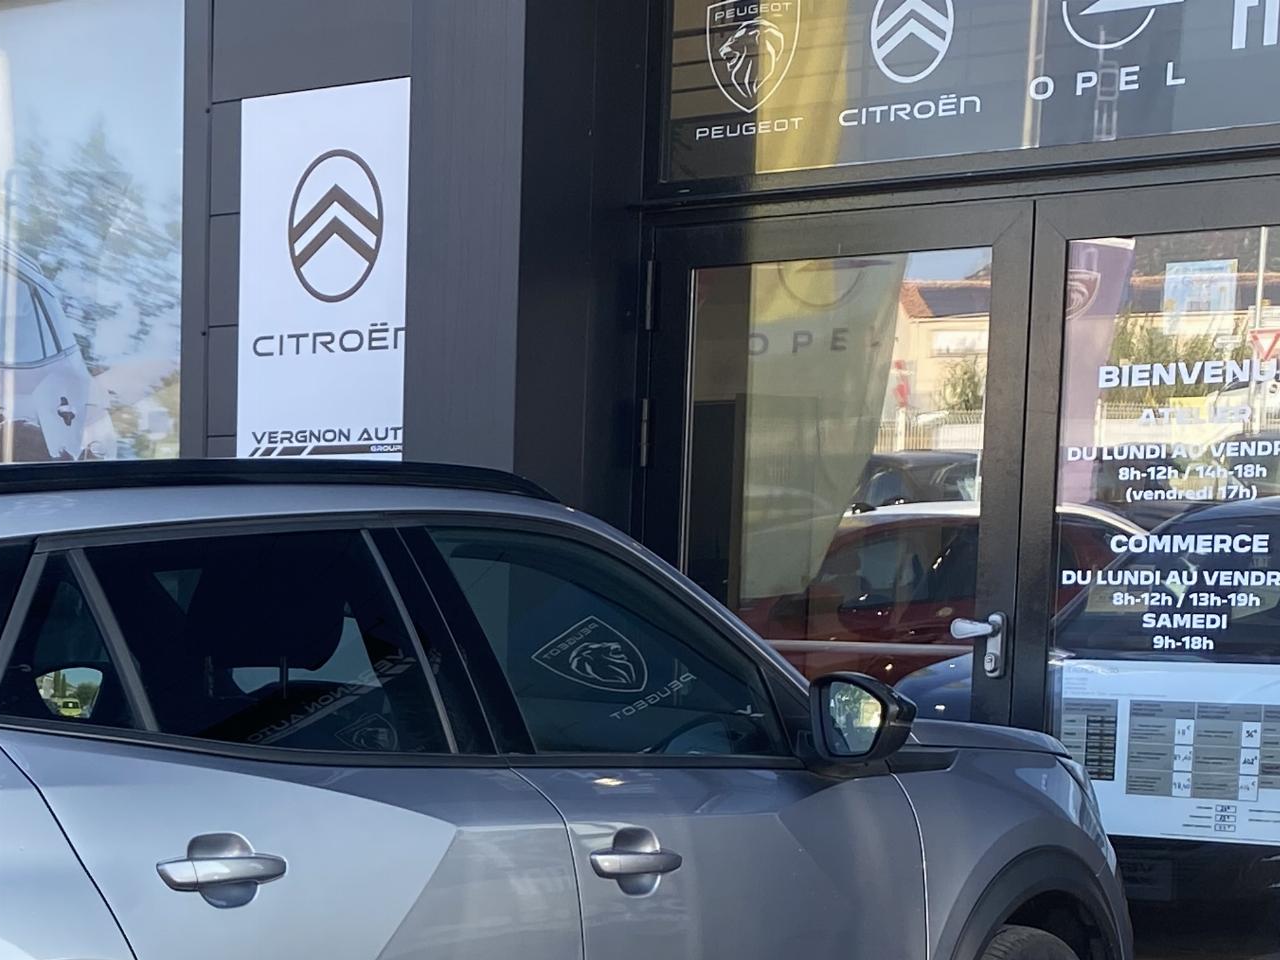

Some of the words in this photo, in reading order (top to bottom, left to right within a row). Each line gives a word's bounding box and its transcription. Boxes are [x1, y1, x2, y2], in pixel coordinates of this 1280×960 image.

[714, 2, 792, 21] PEUGEOT
[1029, 61, 1186, 100] OPEL
[695, 117, 804, 140] PEUGEOT
[1137, 405, 1252, 426] ATELIER
[251, 428, 351, 445] VERGNON
[1067, 446, 1097, 461] DU
[1102, 444, 1167, 461] LUNDI
[1172, 443, 1205, 459] AU
[1118, 465, 1179, 481] 8h-12h
[1195, 463, 1267, 479] 14h-18h
[1125, 486, 1212, 502] (vendredi
[1218, 484, 1258, 501] 17h)
[1110, 533, 1270, 553] COMMERCE
[1061, 570, 1092, 585] DU
[1096, 570, 1161, 585] LUNDI
[1165, 570, 1198, 586] AU
[1112, 592, 1173, 606] 8h-12h
[1176, 592, 1185, 608] /
[1189, 592, 1261, 607] 13h-19h
[1142, 613, 1228, 629] SAMEDI
[1152, 635, 1214, 650] 9h-18h
